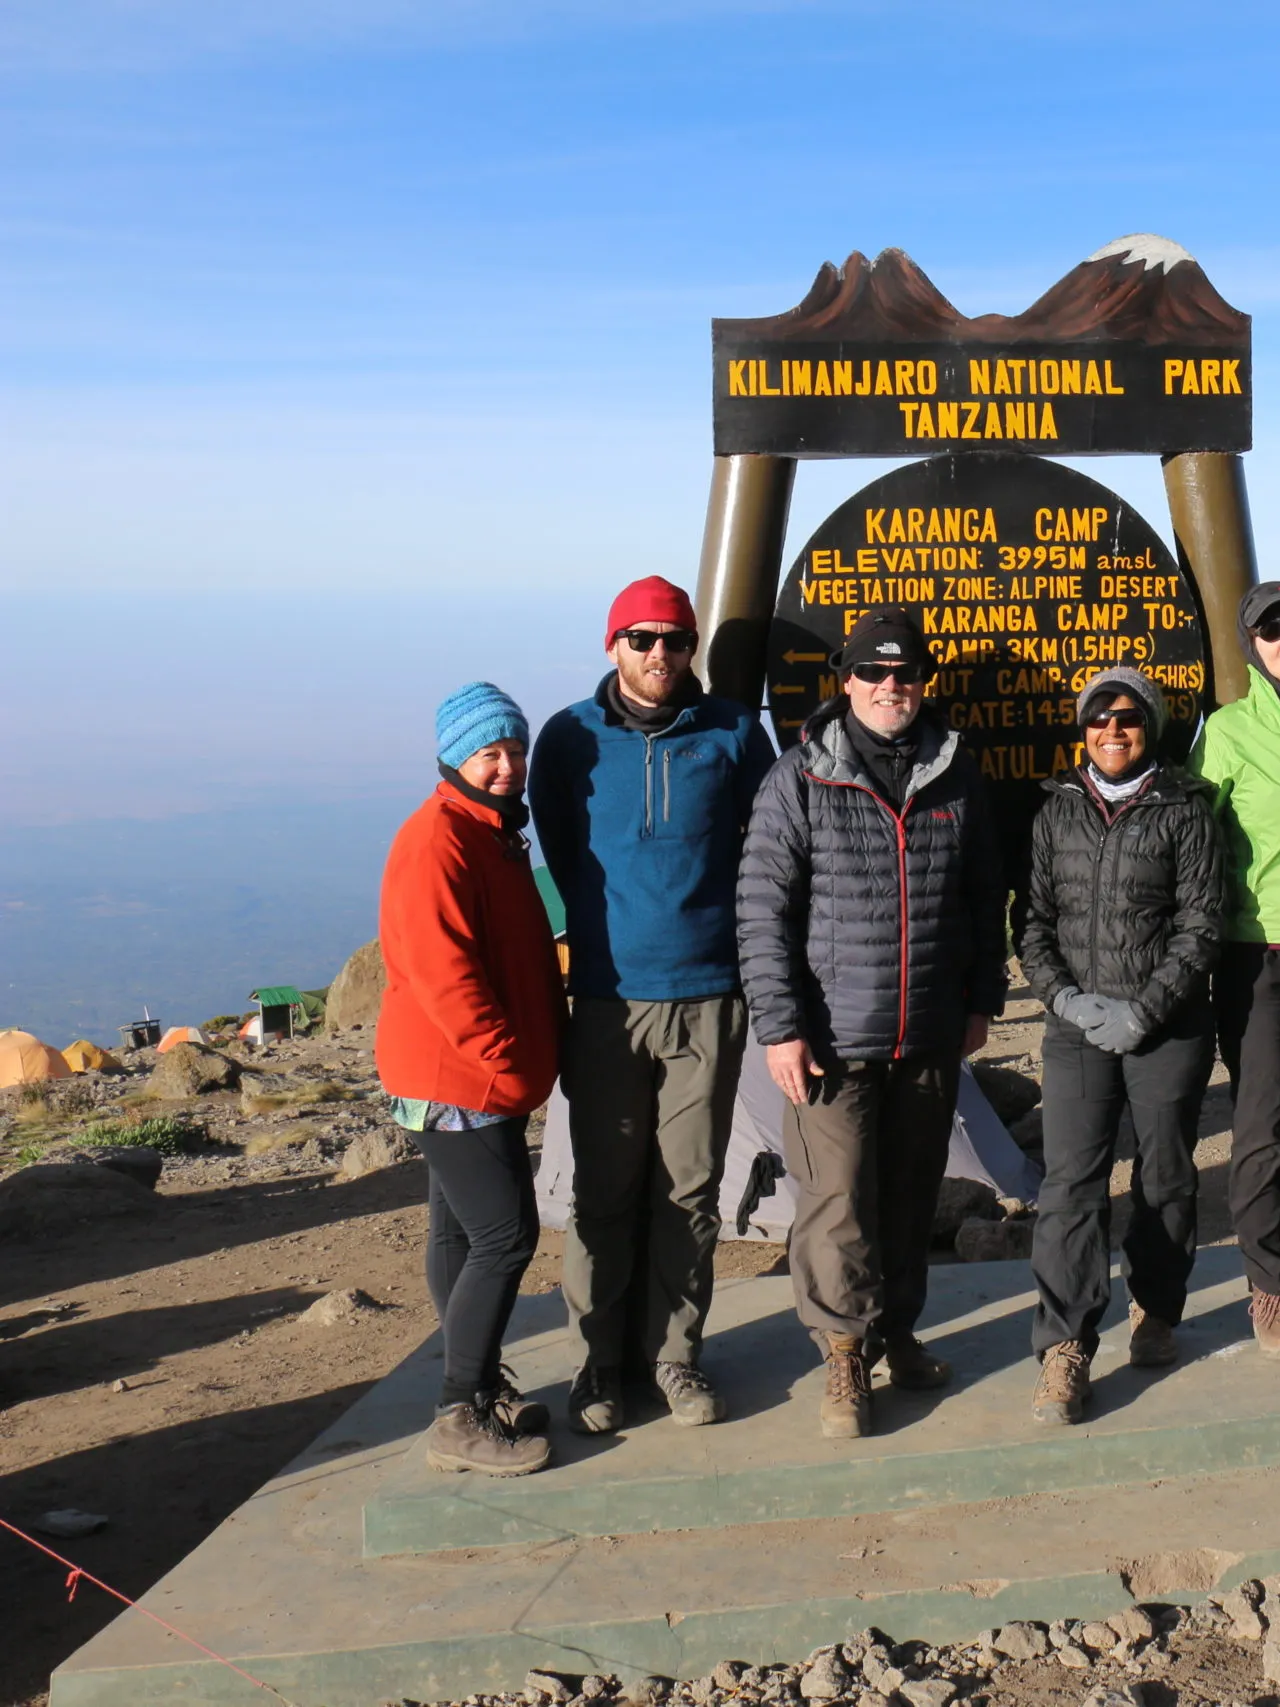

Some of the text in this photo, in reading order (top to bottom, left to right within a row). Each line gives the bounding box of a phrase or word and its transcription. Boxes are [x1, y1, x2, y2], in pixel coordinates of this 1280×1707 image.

[729, 359, 1242, 397] KILIMANJARO NATIONAL PARK
[900, 402, 1058, 440] TANZANIA
[865, 508, 1108, 544] KARANGA CAMP
[812, 546, 1157, 574] ELEVATION: 3995M amsl
[799, 578, 934, 605] VEGETATION
[1010, 576, 1082, 600] ALPINE
[1101, 576, 1179, 599] DESERT
[923, 606, 1038, 634] KARANGA
[1058, 604, 1128, 631] CAMP
